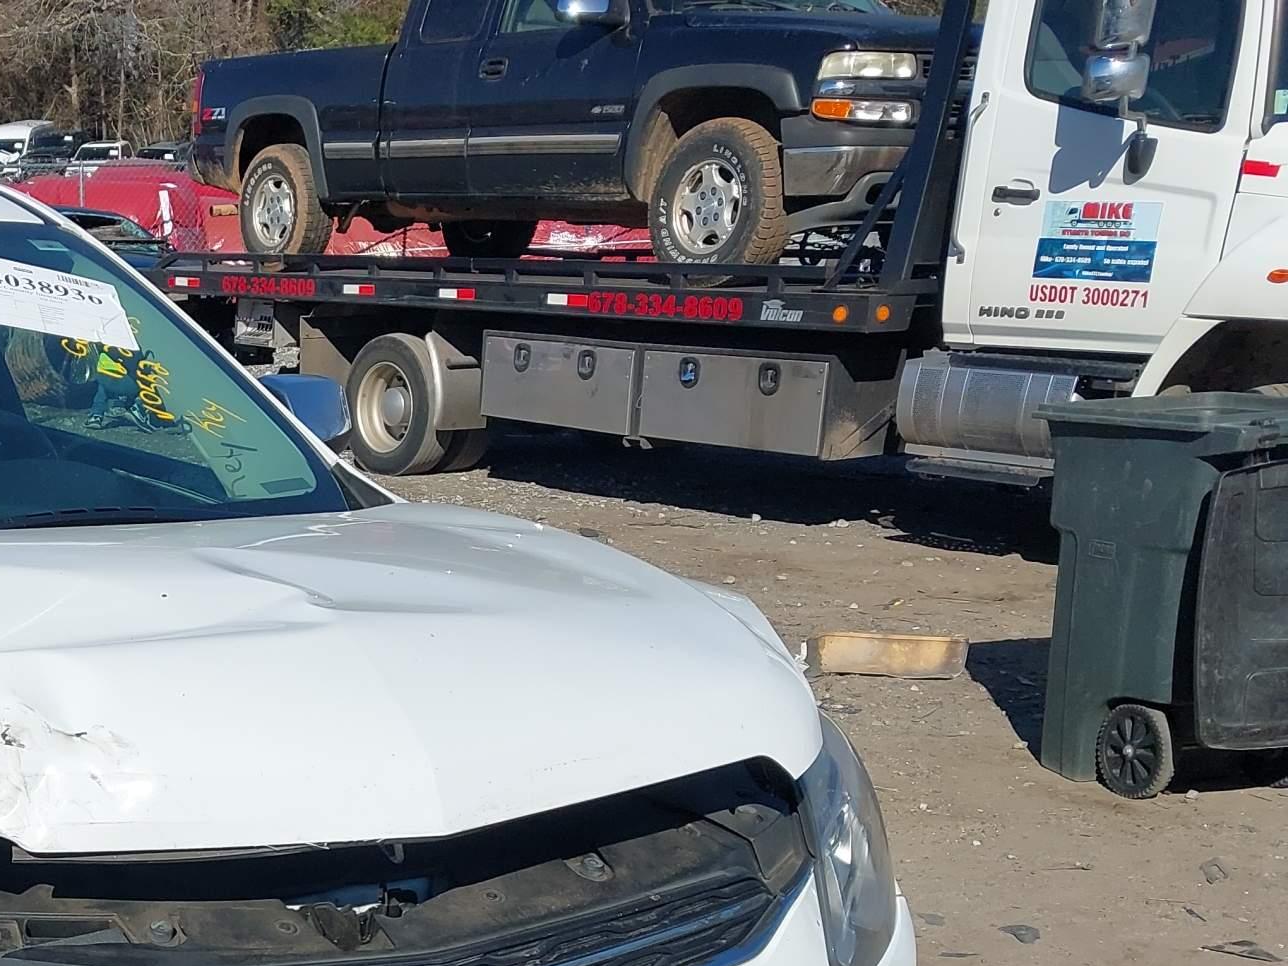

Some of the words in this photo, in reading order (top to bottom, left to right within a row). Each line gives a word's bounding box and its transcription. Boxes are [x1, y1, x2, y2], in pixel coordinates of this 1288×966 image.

[202, 106, 226, 120] Z71
[222, 275, 316, 296] 678-334-8609
[1029, 284, 1077, 304] USDOT
[1082, 287, 1149, 308] 3000271
[587, 291, 744, 321] 678-334-8609
[979, 306, 1030, 319] HINO
